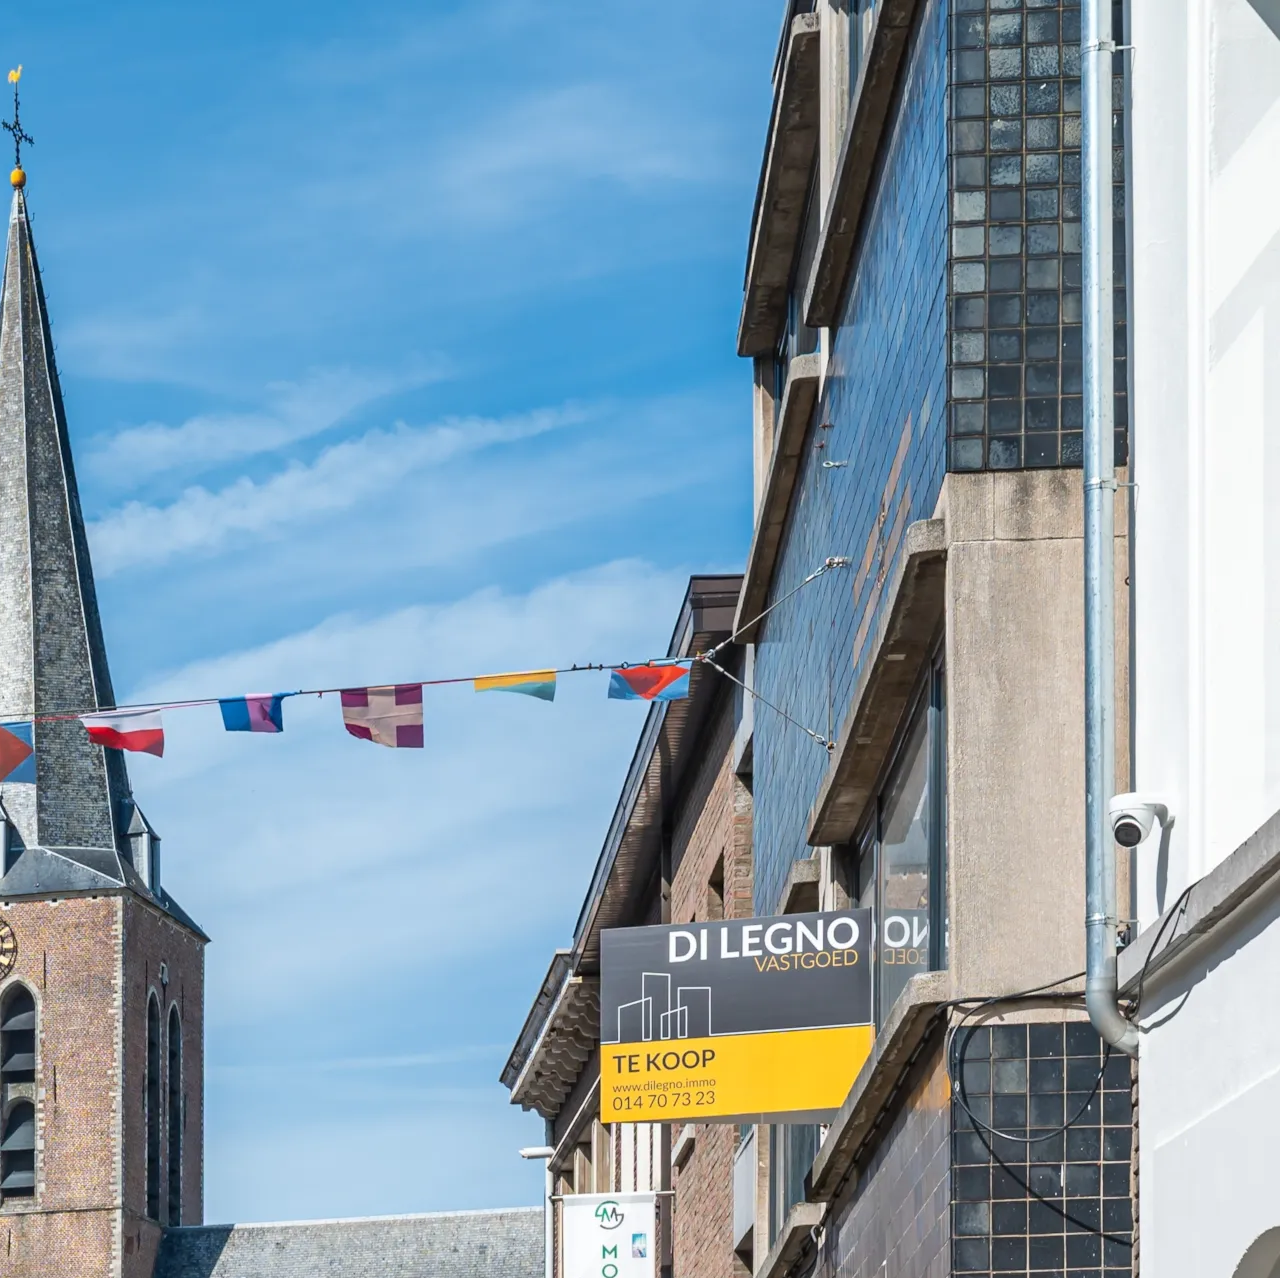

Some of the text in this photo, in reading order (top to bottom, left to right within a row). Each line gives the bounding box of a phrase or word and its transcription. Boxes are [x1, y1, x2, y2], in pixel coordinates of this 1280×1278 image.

[668, 916, 860, 963] DI LEGNO
[754, 948, 858, 973] VASTGOED
[612, 1049, 715, 1074] TE KOOP
[612, 1077, 716, 1093] www.dilegno.immo
[612, 1090, 716, 1111] 014 70 73 23
